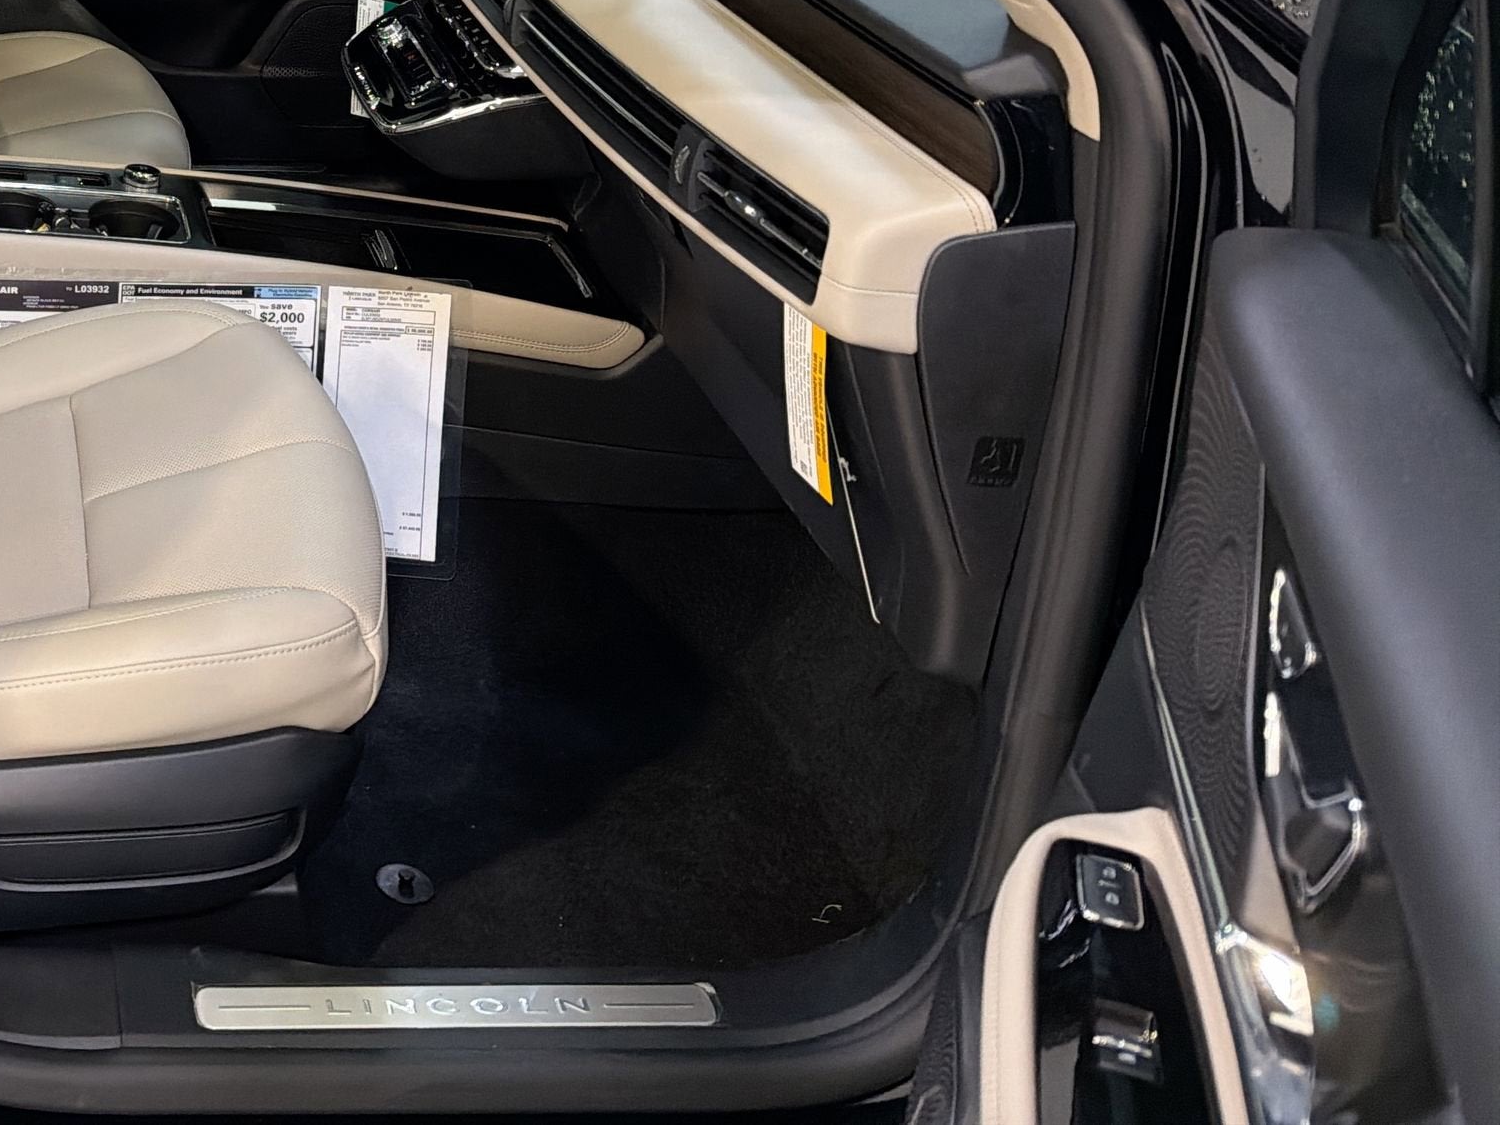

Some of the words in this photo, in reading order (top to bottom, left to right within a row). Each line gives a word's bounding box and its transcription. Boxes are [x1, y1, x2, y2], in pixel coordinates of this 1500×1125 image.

[74, 284, 110, 294] L03932
[153, 288, 185, 297] Economy
[185, 288, 199, 296] and
[199, 288, 243, 296] Environment
[259, 311, 305, 324] $2,000
[326, 996, 592, 1016] LINCOLN
